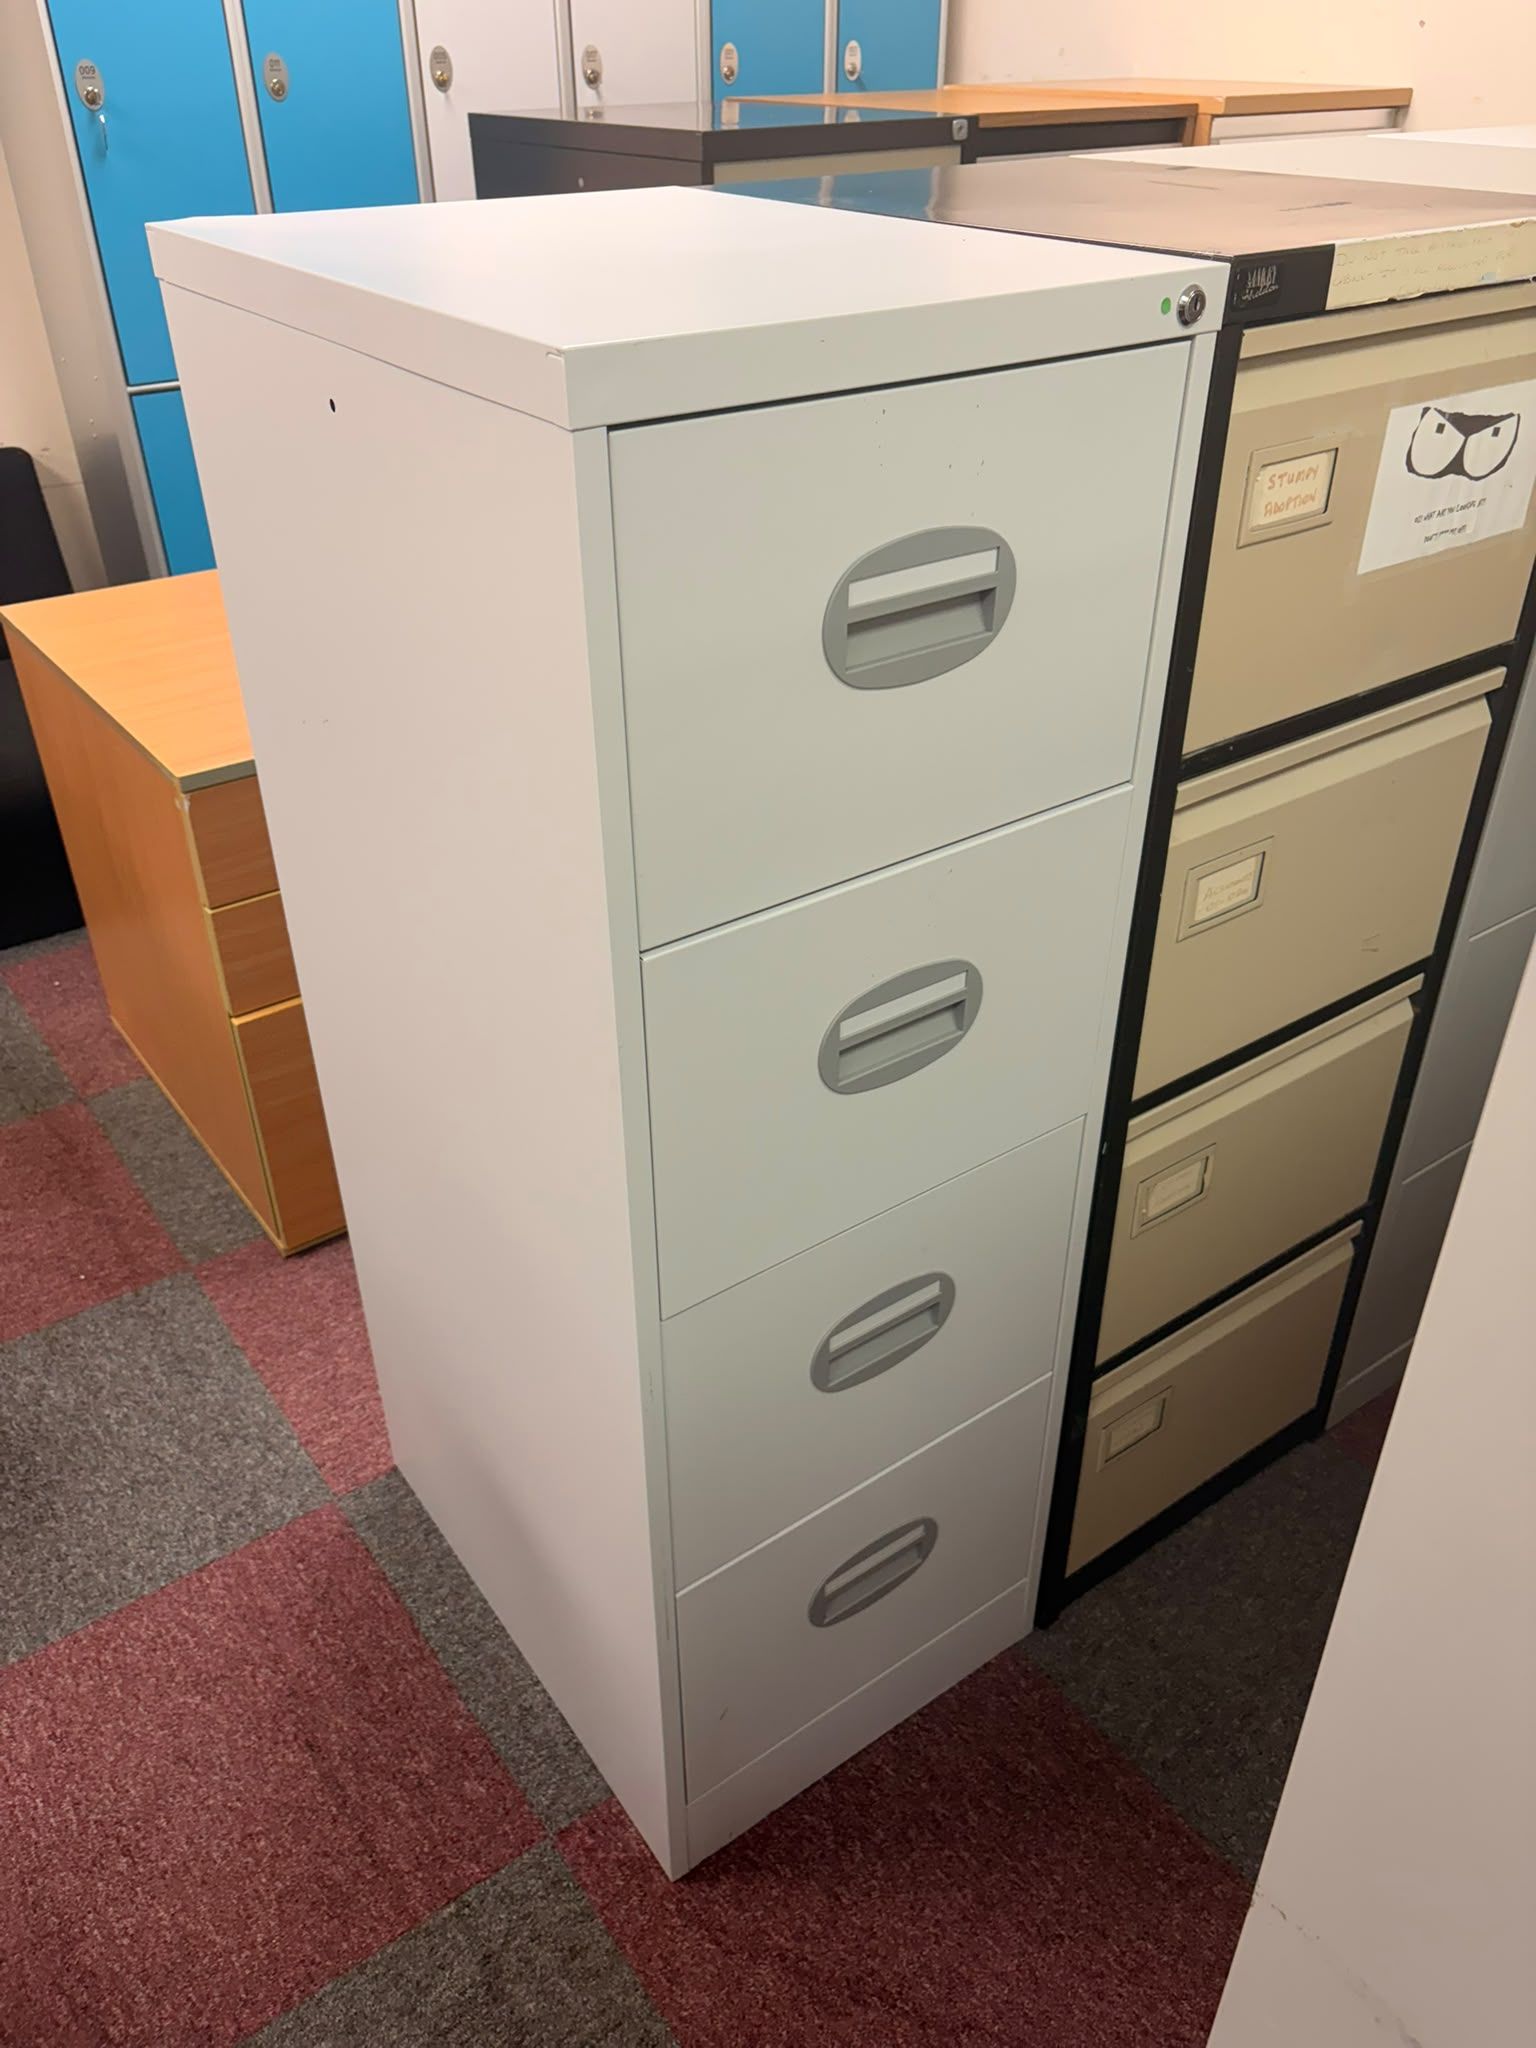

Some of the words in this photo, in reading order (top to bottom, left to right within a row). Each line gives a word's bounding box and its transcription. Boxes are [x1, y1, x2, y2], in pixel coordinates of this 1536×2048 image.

[79, 65, 96, 75] 009
[1267, 464, 1320, 490] STUMPY
[1264, 487, 1319, 517] ADOPTION
